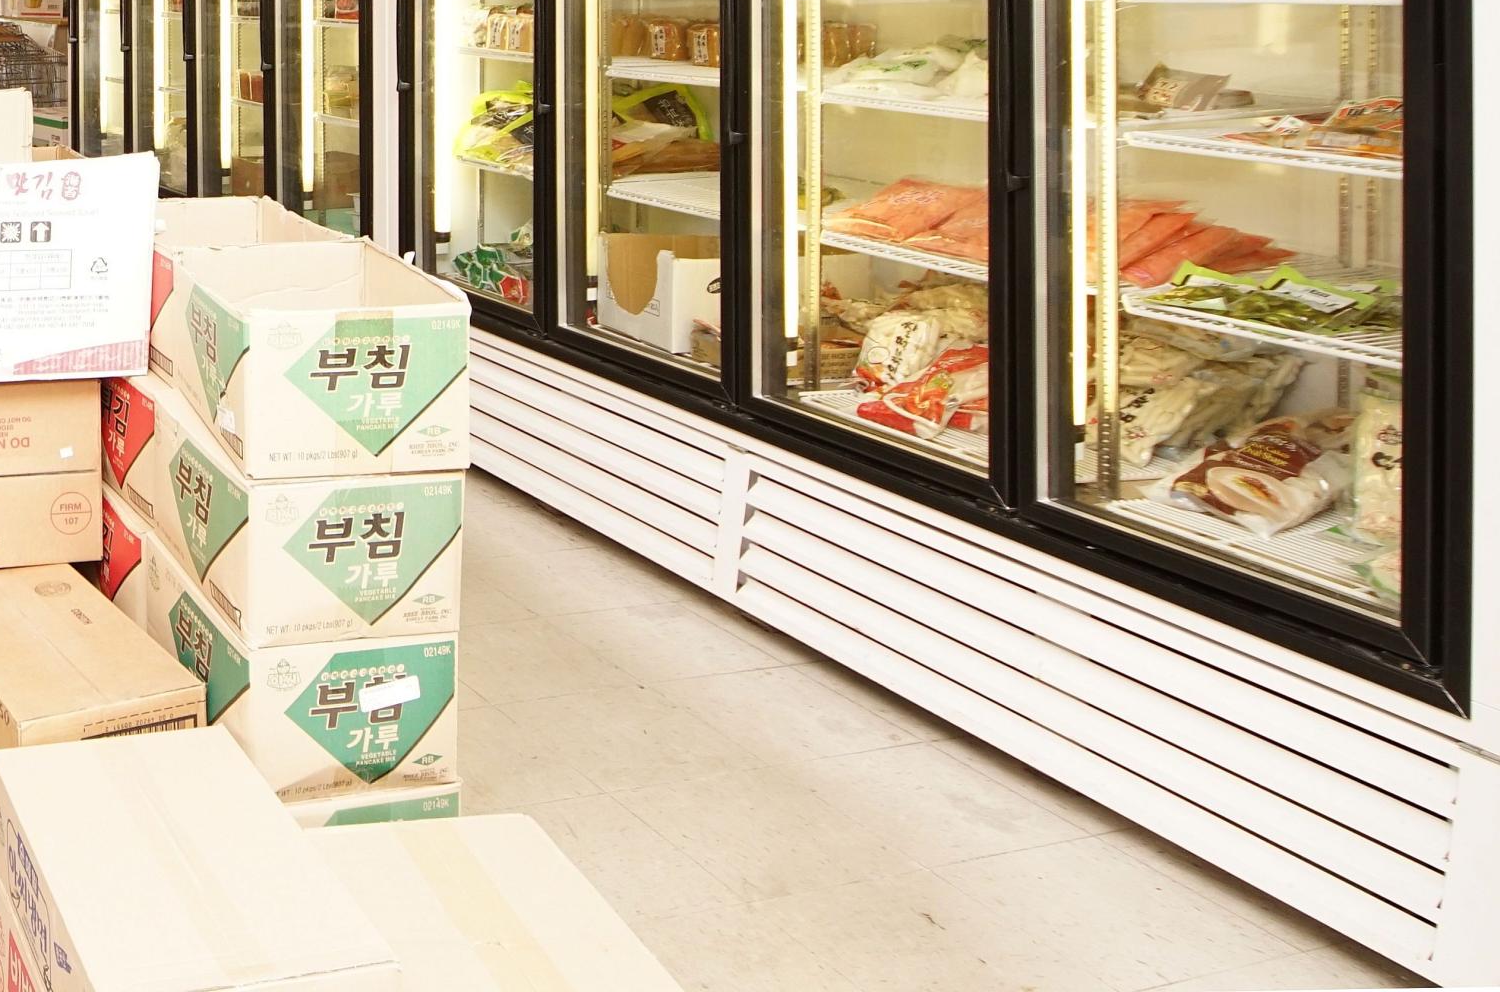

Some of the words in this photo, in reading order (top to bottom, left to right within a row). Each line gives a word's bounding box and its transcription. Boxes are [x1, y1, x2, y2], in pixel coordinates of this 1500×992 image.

[190, 302, 218, 365] 부침
[430, 319, 461, 331] 02149K
[308, 343, 412, 394] 부침
[346, 391, 404, 418] 가루
[10, 436, 30, 449] DO
[108, 430, 125, 458] 가루
[269, 451, 281, 462] NET
[176, 456, 213, 528] 부침
[424, 485, 453, 497] 02149K
[59, 502, 82, 512] FIRM
[64, 517, 79, 525] 107
[186, 514, 207, 546] 가루
[307, 510, 406, 565] 부침
[344, 560, 399, 588] 가루
[422, 595, 436, 604] RB
[266, 625, 279, 635] NET
[176, 606, 213, 683] 부침
[424, 646, 452, 658] 02149K
[346, 724, 400, 753] 가루
[420, 756, 434, 765] RB
